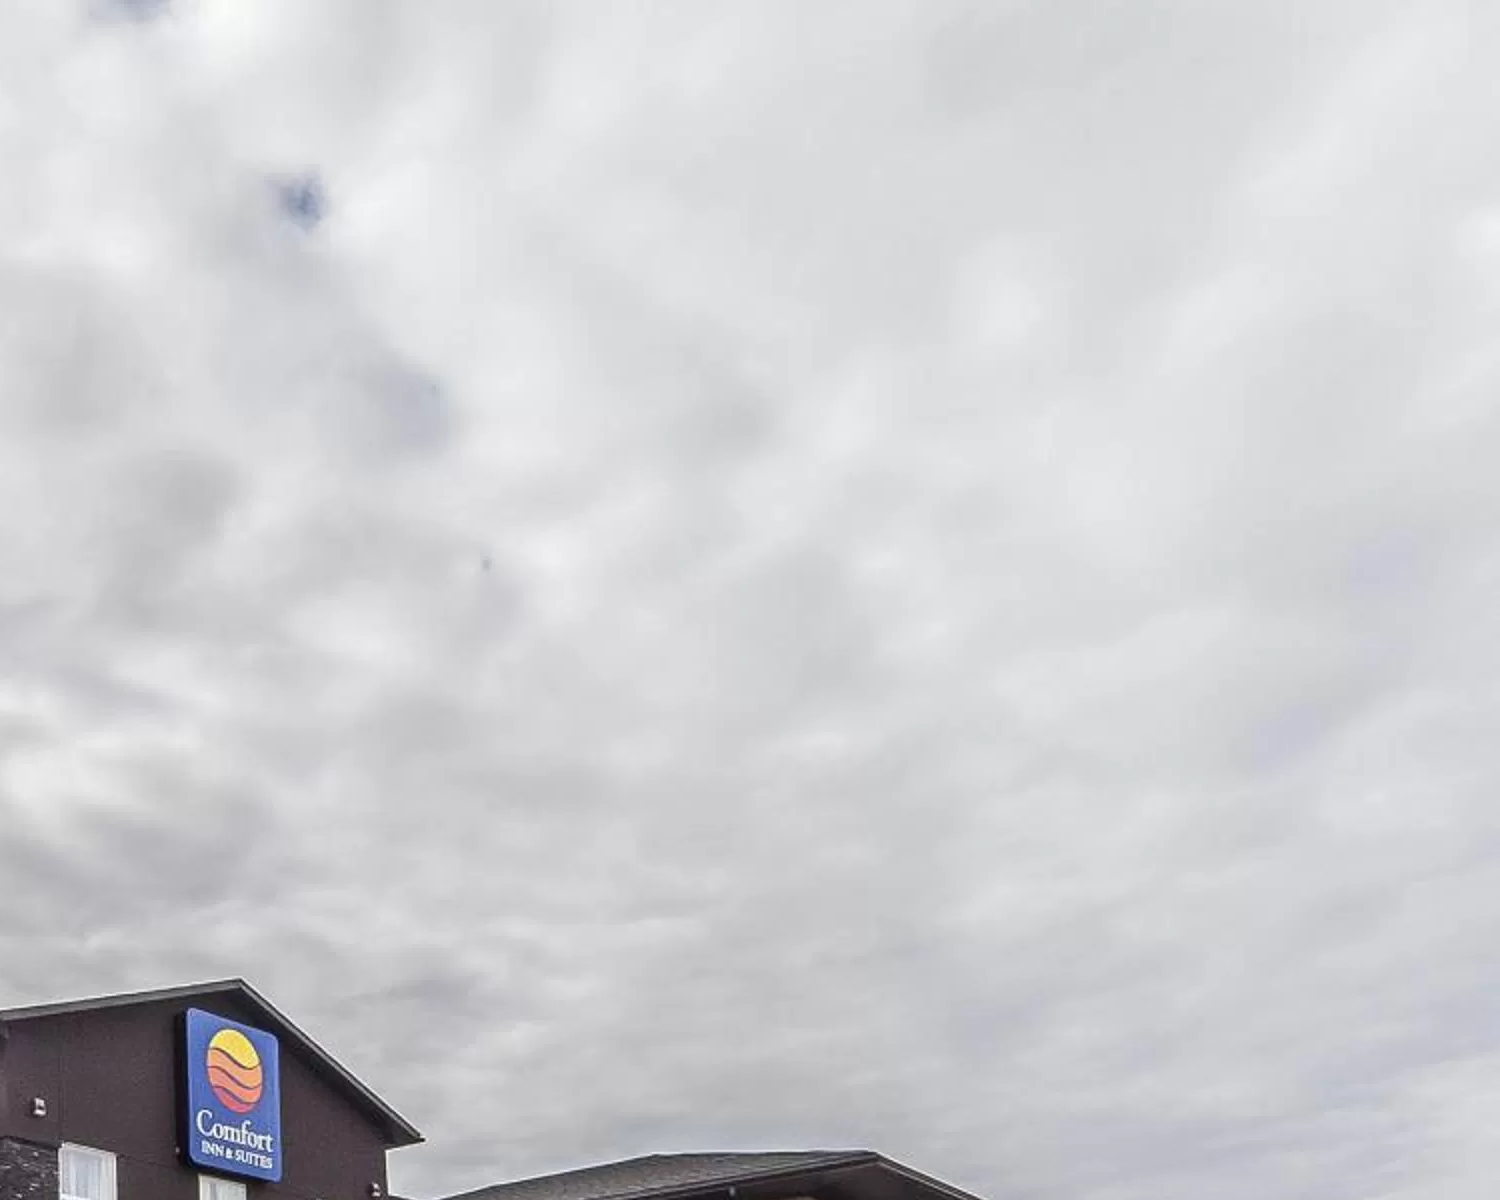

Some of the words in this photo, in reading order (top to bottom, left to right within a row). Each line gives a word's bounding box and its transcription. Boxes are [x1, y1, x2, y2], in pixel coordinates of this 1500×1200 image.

[196, 1109, 274, 1152] Comfort
[201, 1140, 224, 1157] INN
[226, 1147, 233, 1159] &
[235, 1149, 273, 1169] SUITES
